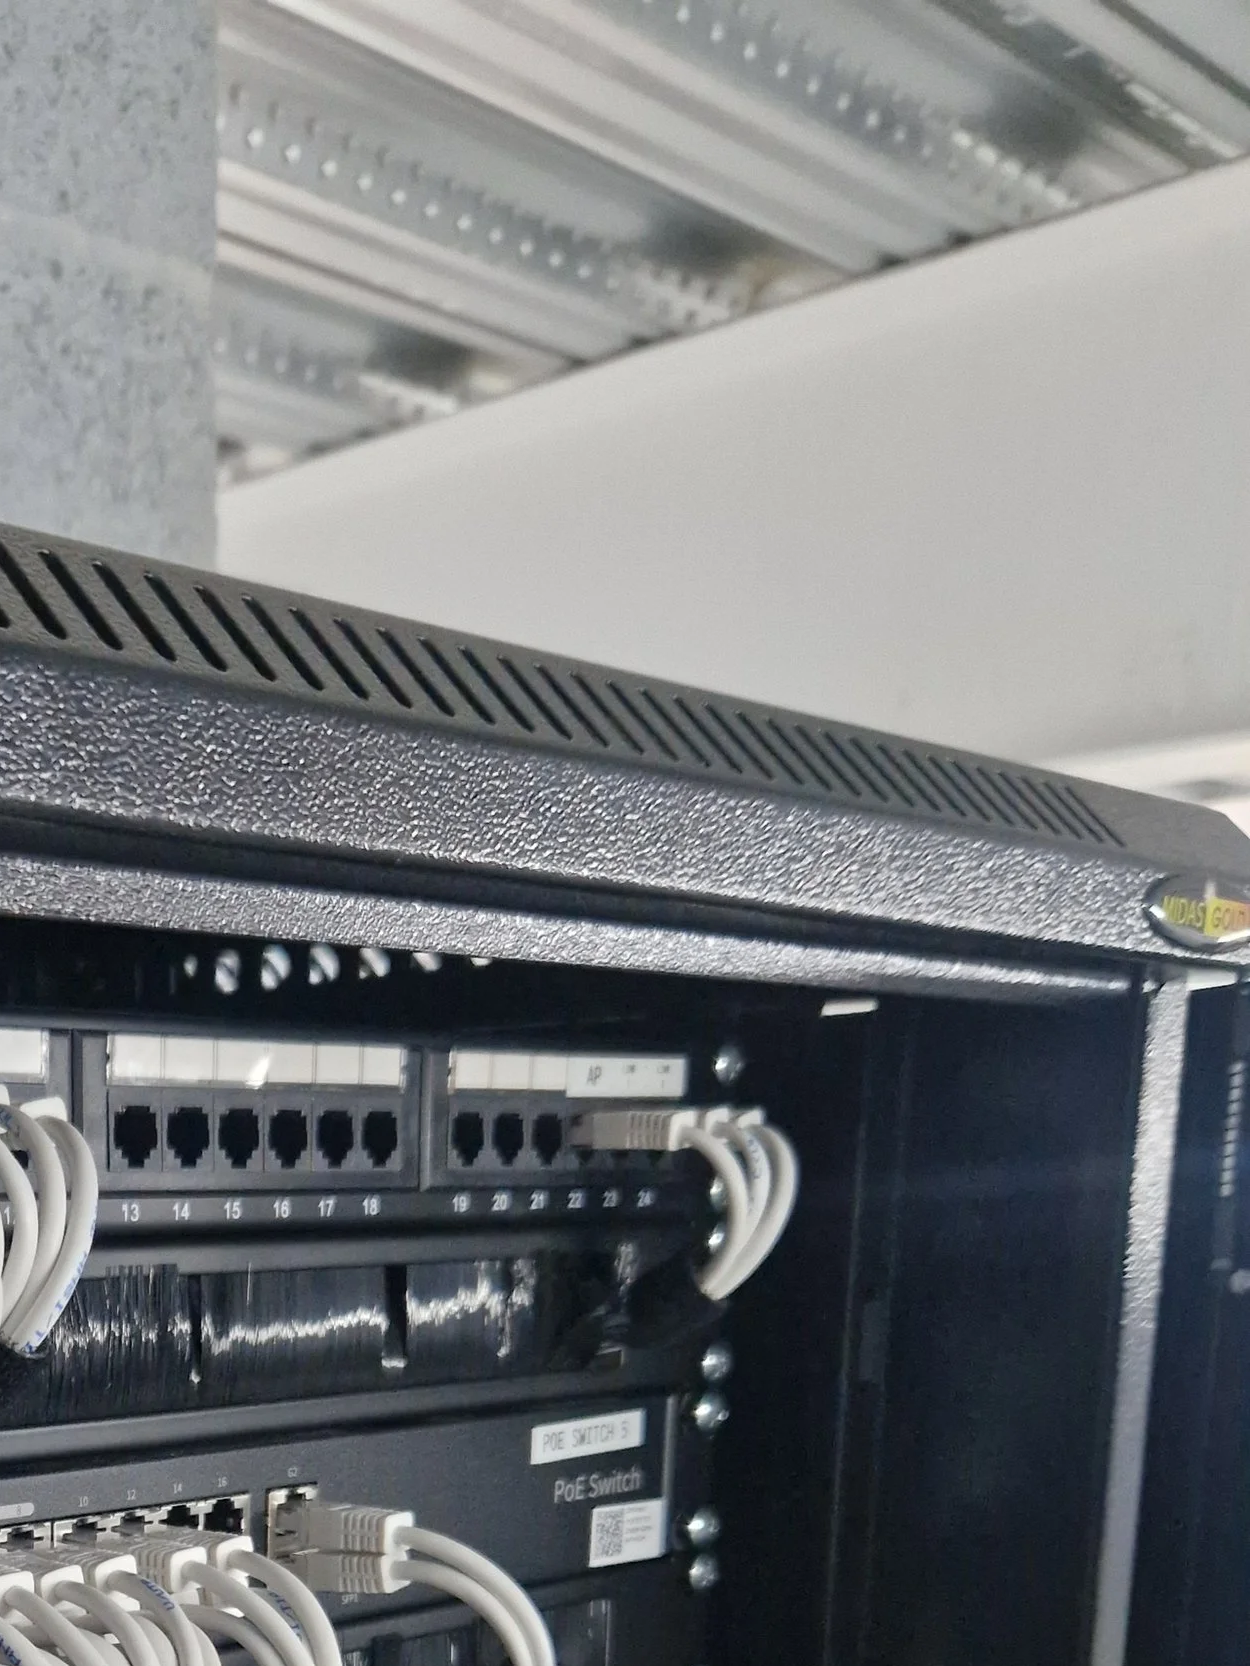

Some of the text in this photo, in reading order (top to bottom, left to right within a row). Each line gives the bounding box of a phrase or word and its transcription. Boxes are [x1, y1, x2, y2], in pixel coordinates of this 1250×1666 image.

[121, 1196, 381, 1222] 13 14 15 16 17 18
[452, 1193, 470, 1213] 19
[491, 1192, 511, 1212] 20
[530, 1191, 548, 1210] 21
[567, 1189, 587, 1209] 22
[542, 1431, 565, 1453] POE
[571, 1421, 615, 1448] SWITCH
[78, 1476, 228, 1508] 10 12 14 16
[553, 1464, 643, 1504] PoE Switch
